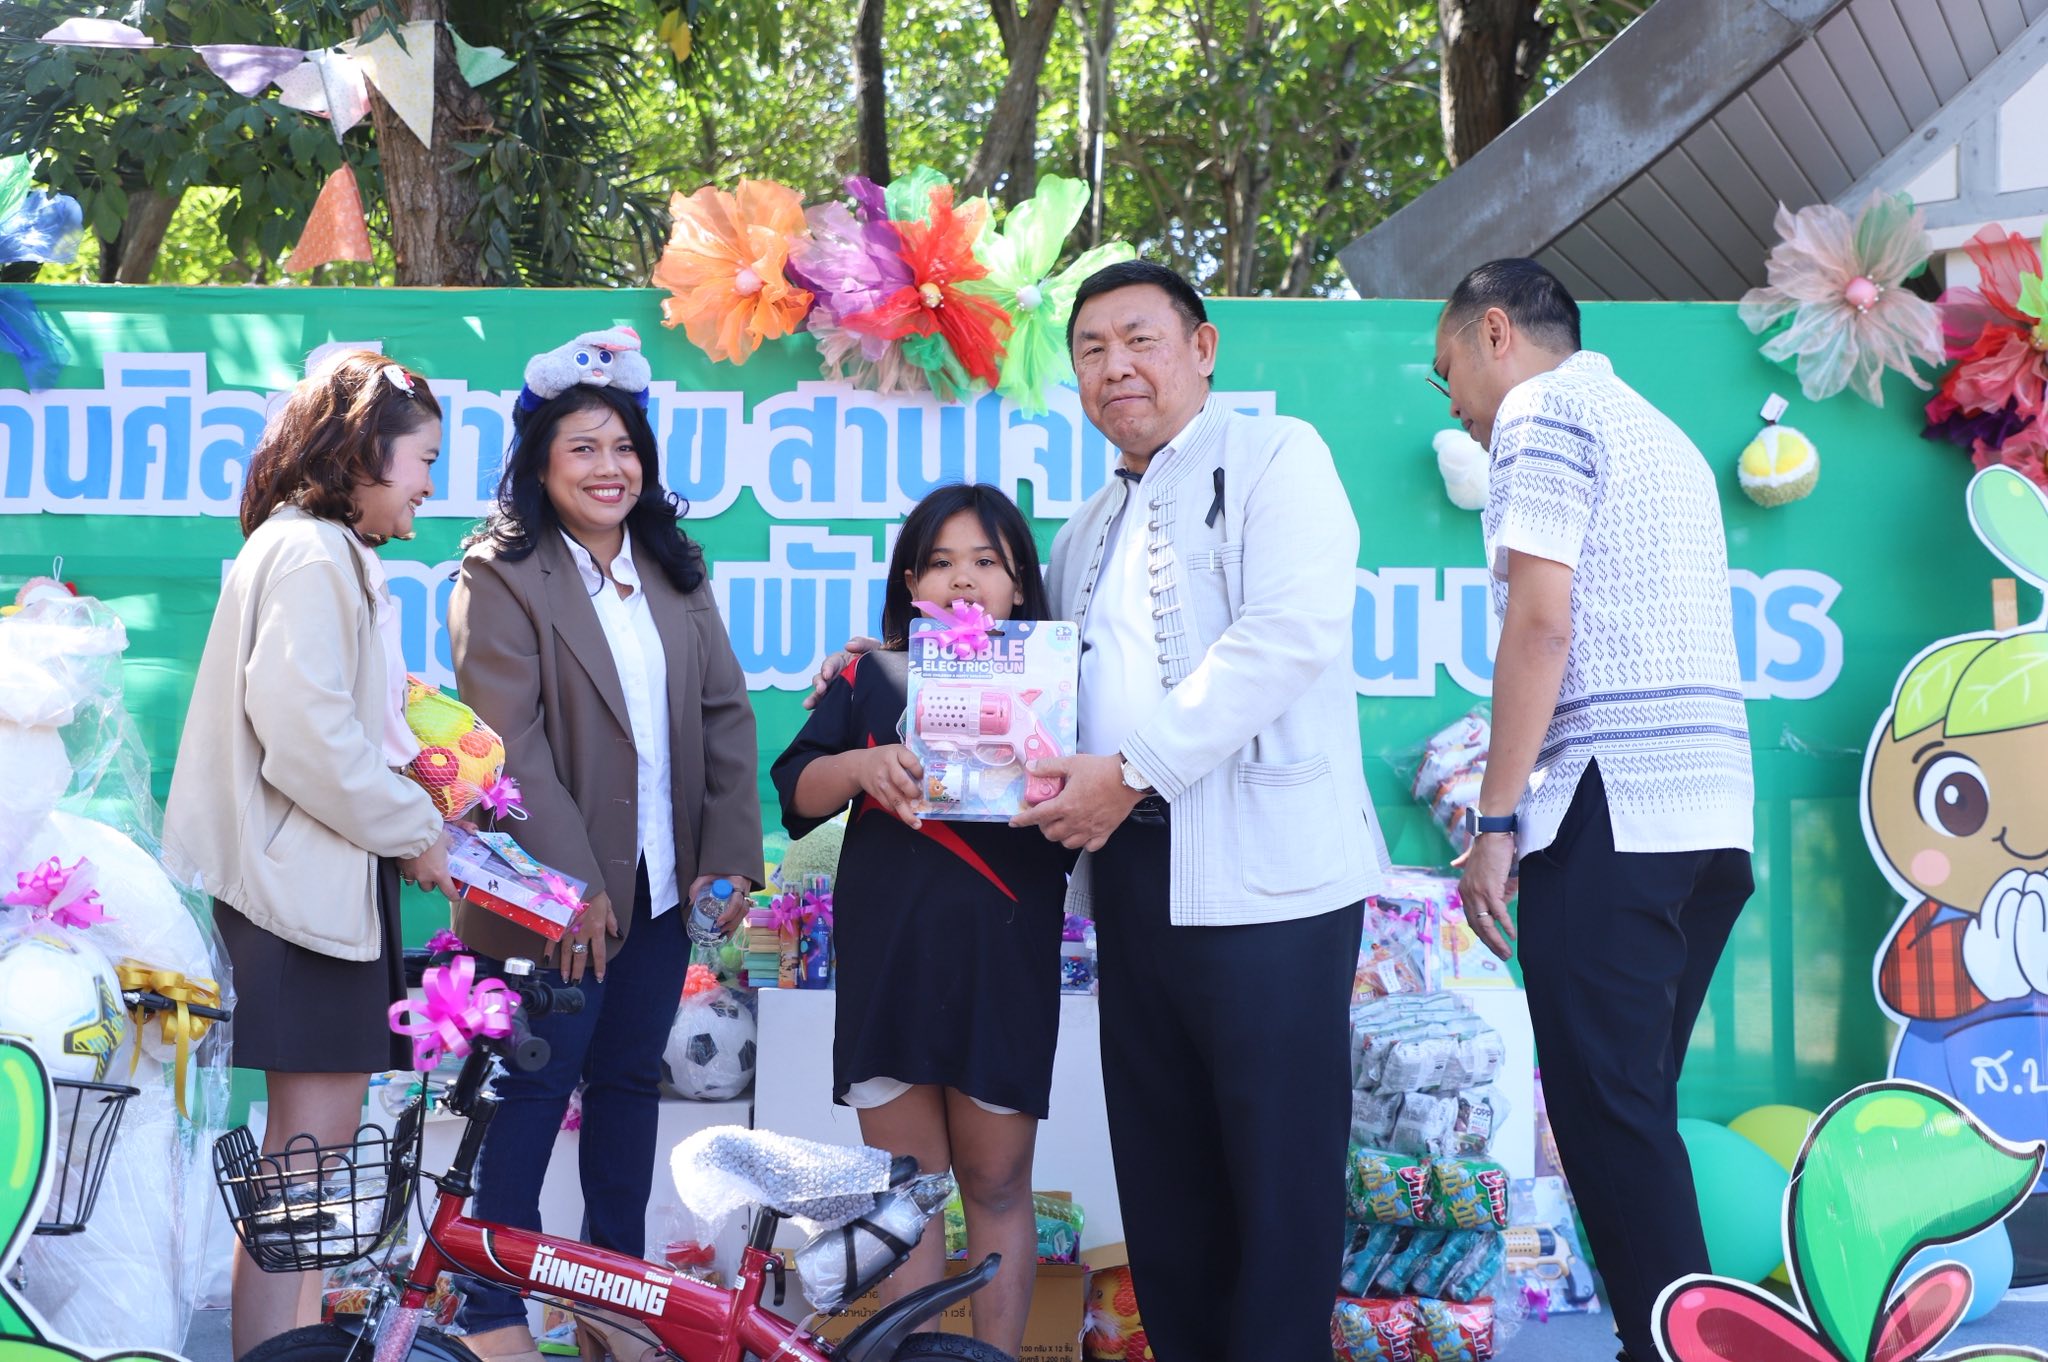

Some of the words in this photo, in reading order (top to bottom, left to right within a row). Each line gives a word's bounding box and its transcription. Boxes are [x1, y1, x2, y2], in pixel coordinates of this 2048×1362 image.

[923, 638, 1025, 662] BUBLE
[922, 660, 990, 673] ELECTRIC
[993, 662, 1024, 674] GUN
[529, 1253, 669, 1317] KINGKONG
